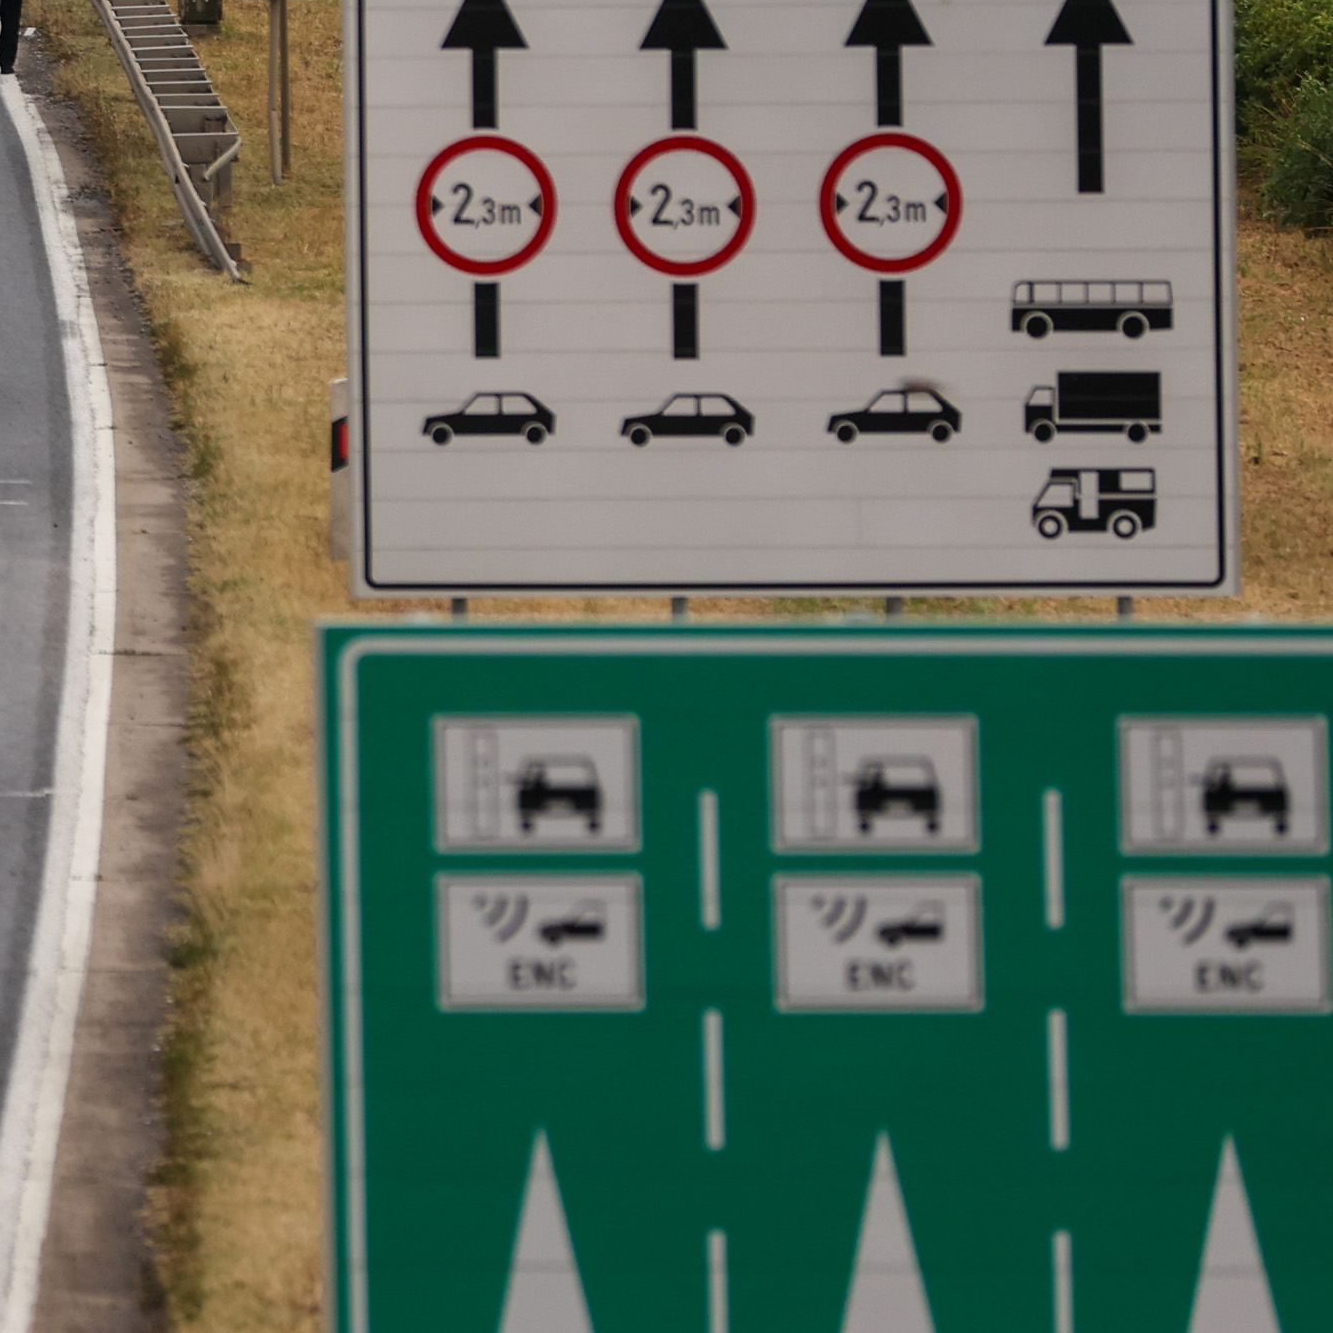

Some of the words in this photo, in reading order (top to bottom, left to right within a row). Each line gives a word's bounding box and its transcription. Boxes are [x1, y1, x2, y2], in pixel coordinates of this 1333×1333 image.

[508, 960, 576, 992] ENC
[847, 961, 915, 993] ENC
[1195, 963, 1263, 994] ENC
